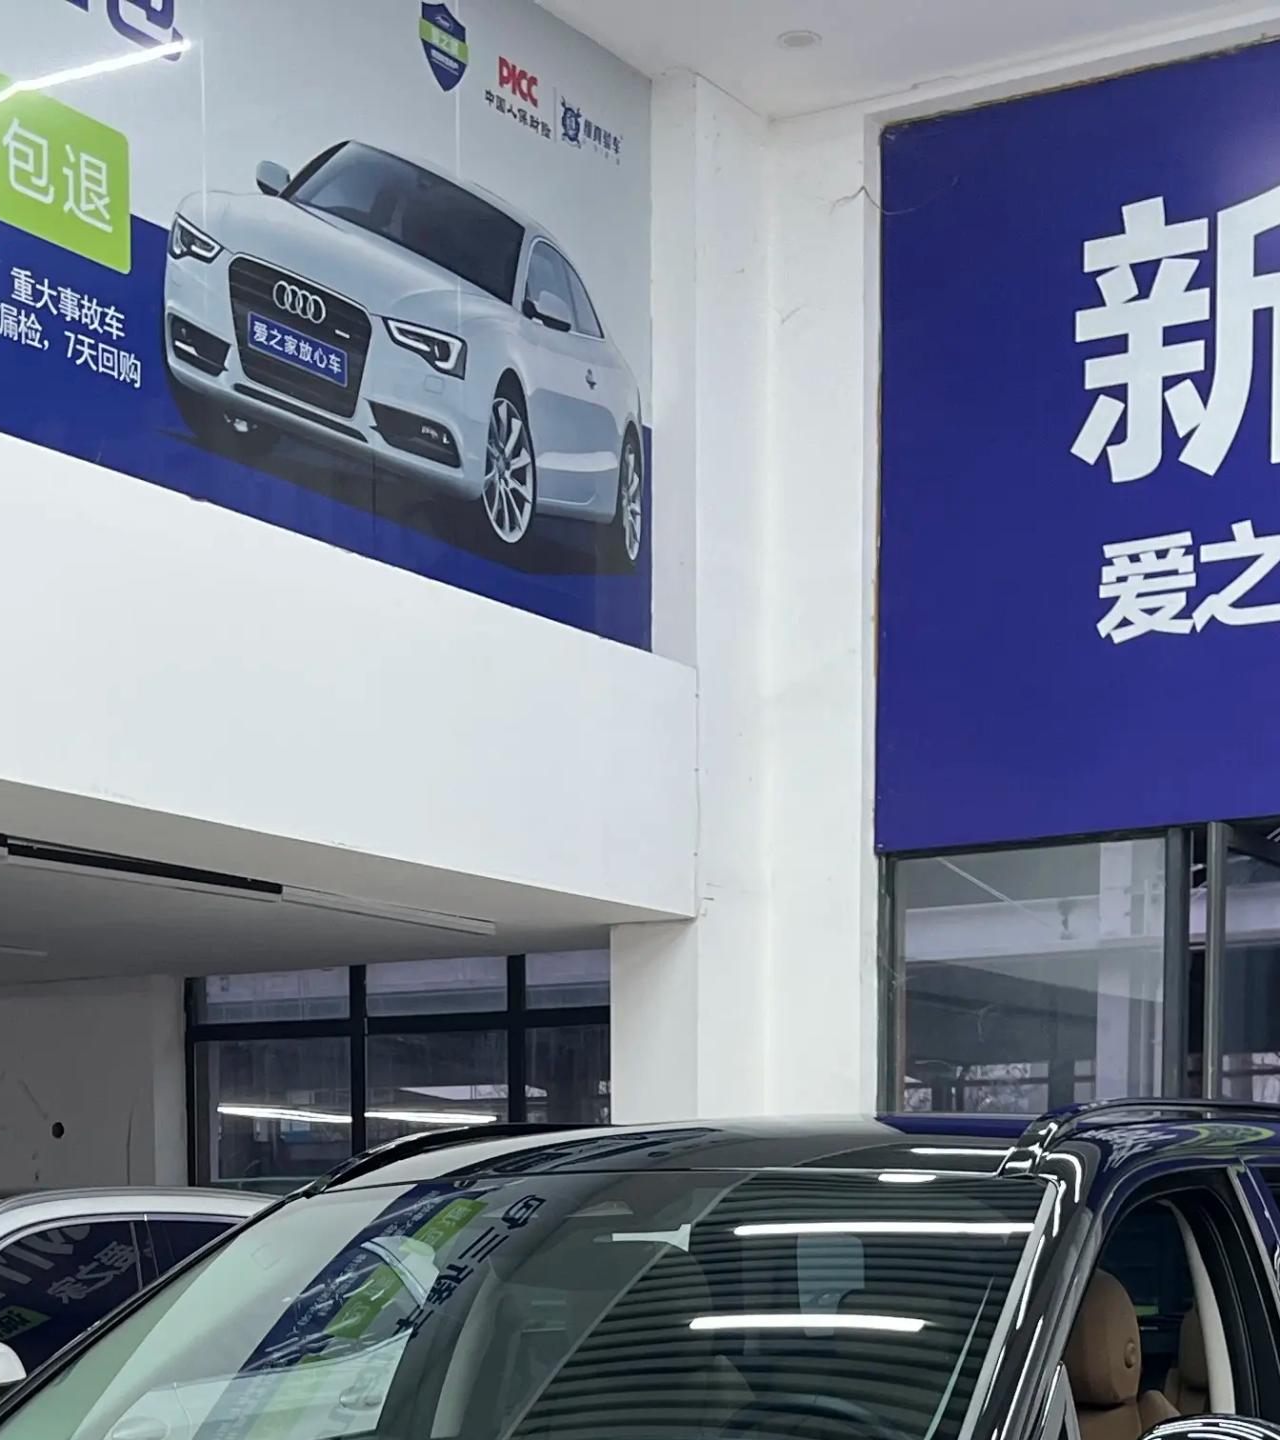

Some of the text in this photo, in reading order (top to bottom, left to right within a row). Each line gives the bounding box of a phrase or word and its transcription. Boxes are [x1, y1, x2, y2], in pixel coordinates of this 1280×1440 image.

[497, 56, 539, 108] PICC
[1, 118, 114, 234] 包退
[10, 266, 126, 341] 重大事故车
[253, 320, 343, 375] 爱之家放心车
